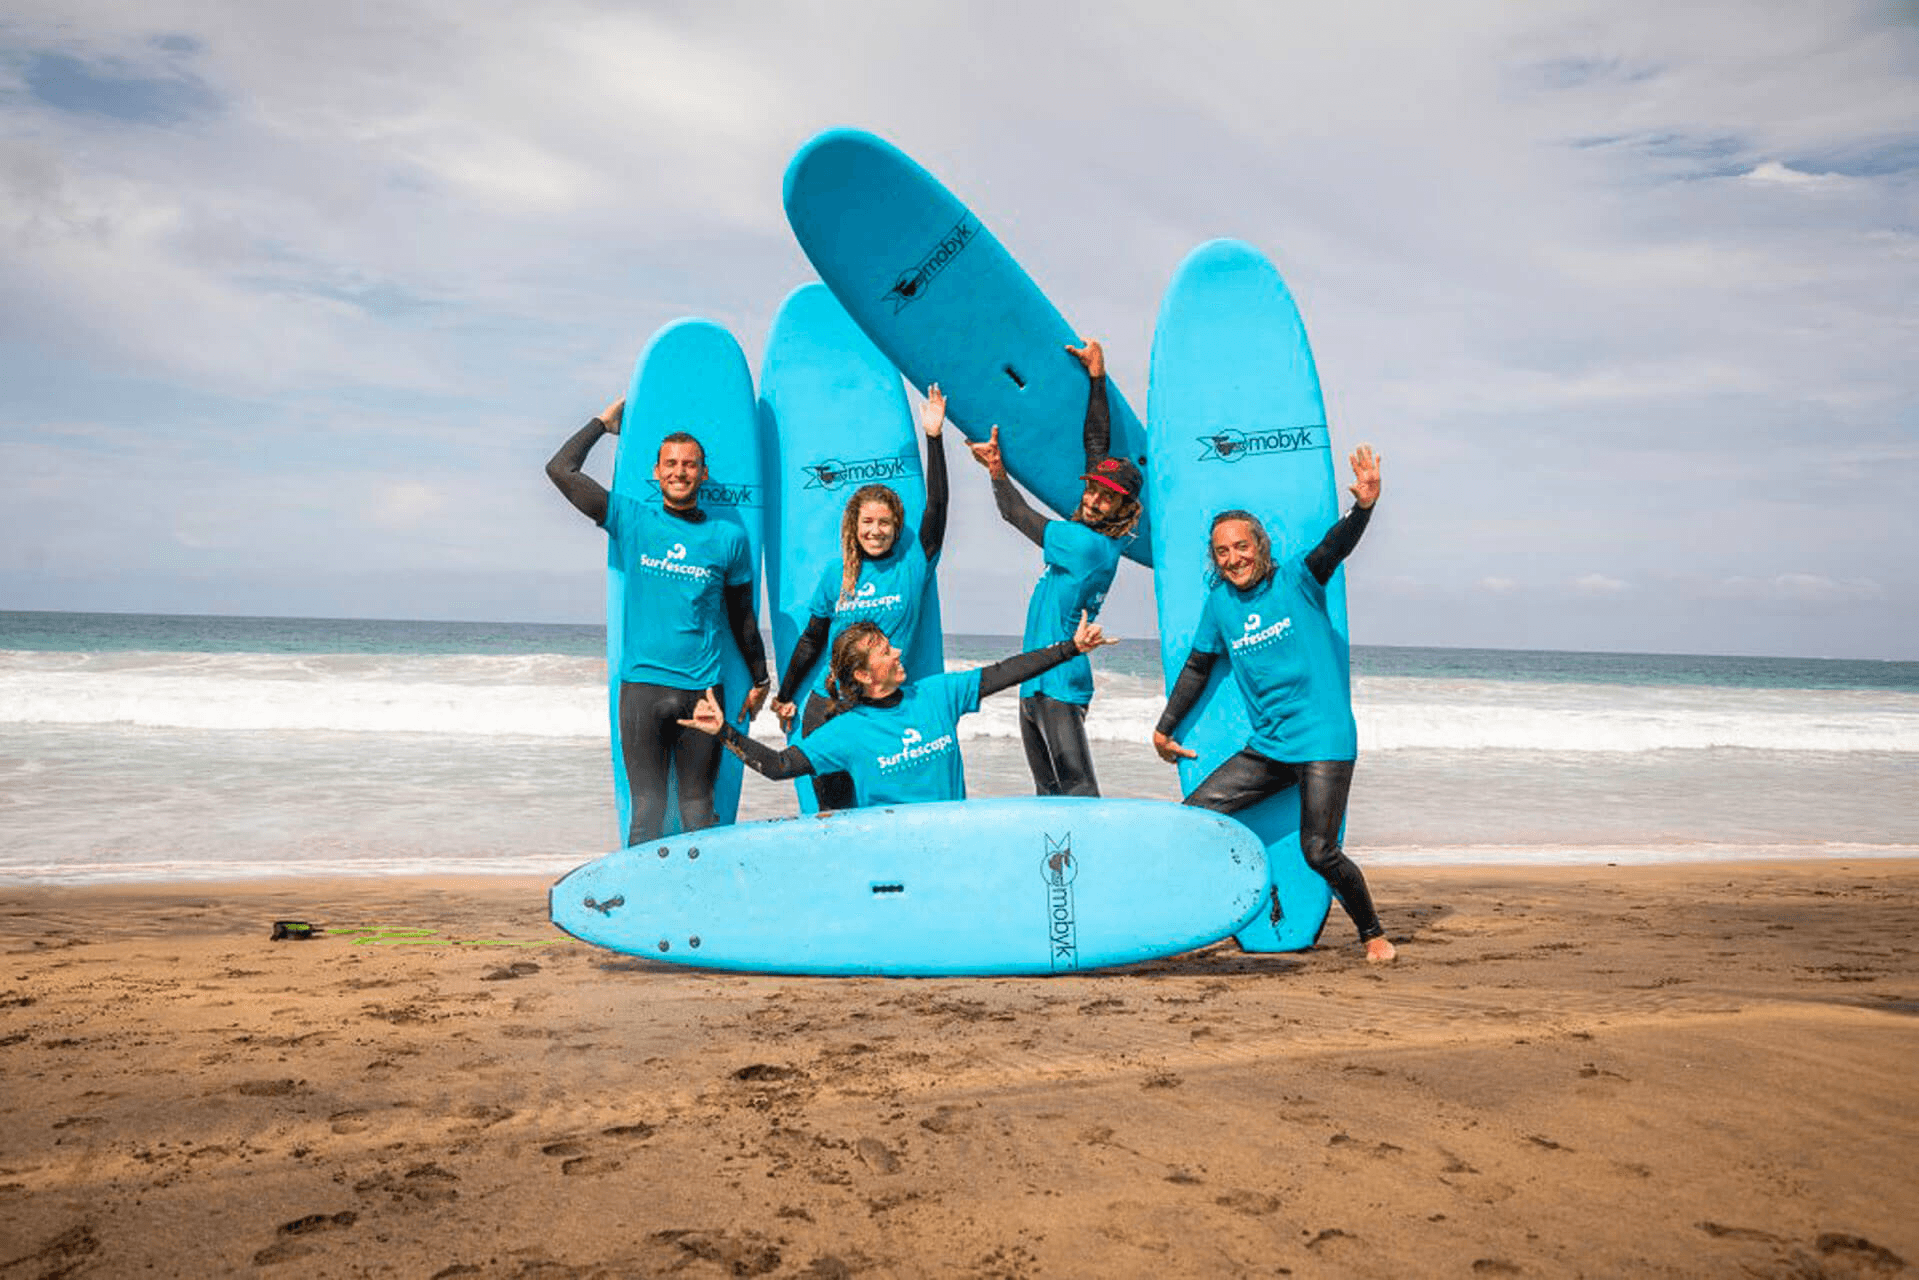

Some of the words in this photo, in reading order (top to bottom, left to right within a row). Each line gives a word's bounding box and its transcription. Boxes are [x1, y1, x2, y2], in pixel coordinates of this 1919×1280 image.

[922, 222, 973, 277] mobyk
[1249, 427, 1313, 451] mobyk
[848, 457, 907, 480] mobyk
[640, 554, 712, 578] Surfescape
[877, 735, 953, 769] Surfescape
[1051, 887, 1076, 958] mobyk
